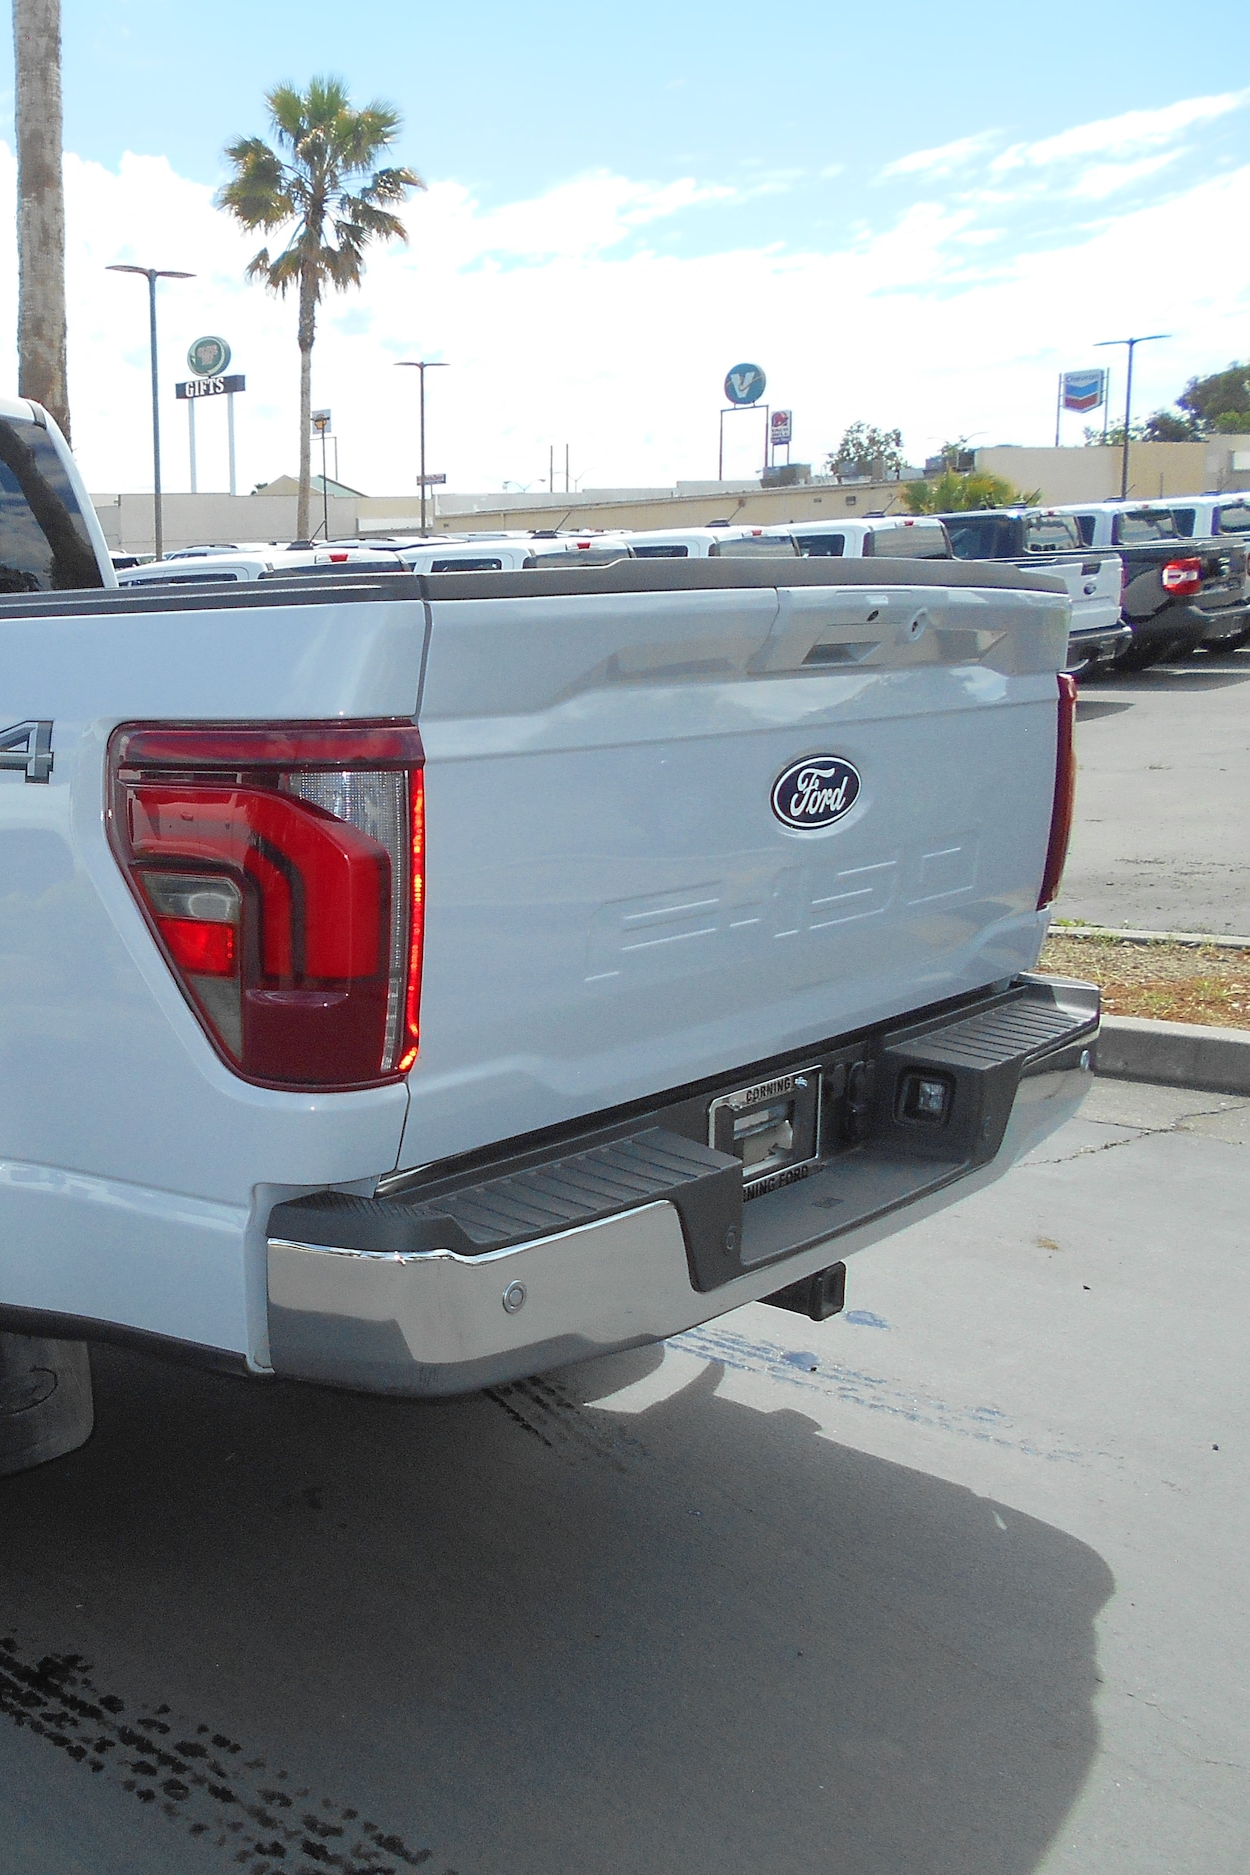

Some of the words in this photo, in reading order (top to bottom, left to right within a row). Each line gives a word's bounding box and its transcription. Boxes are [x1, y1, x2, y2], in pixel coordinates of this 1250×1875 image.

[185, 377, 224, 398] GIFTS
[790, 767, 849, 817] Ford
[746, 1076, 792, 1103] CORNING
[779, 1165, 808, 1188] FORD
